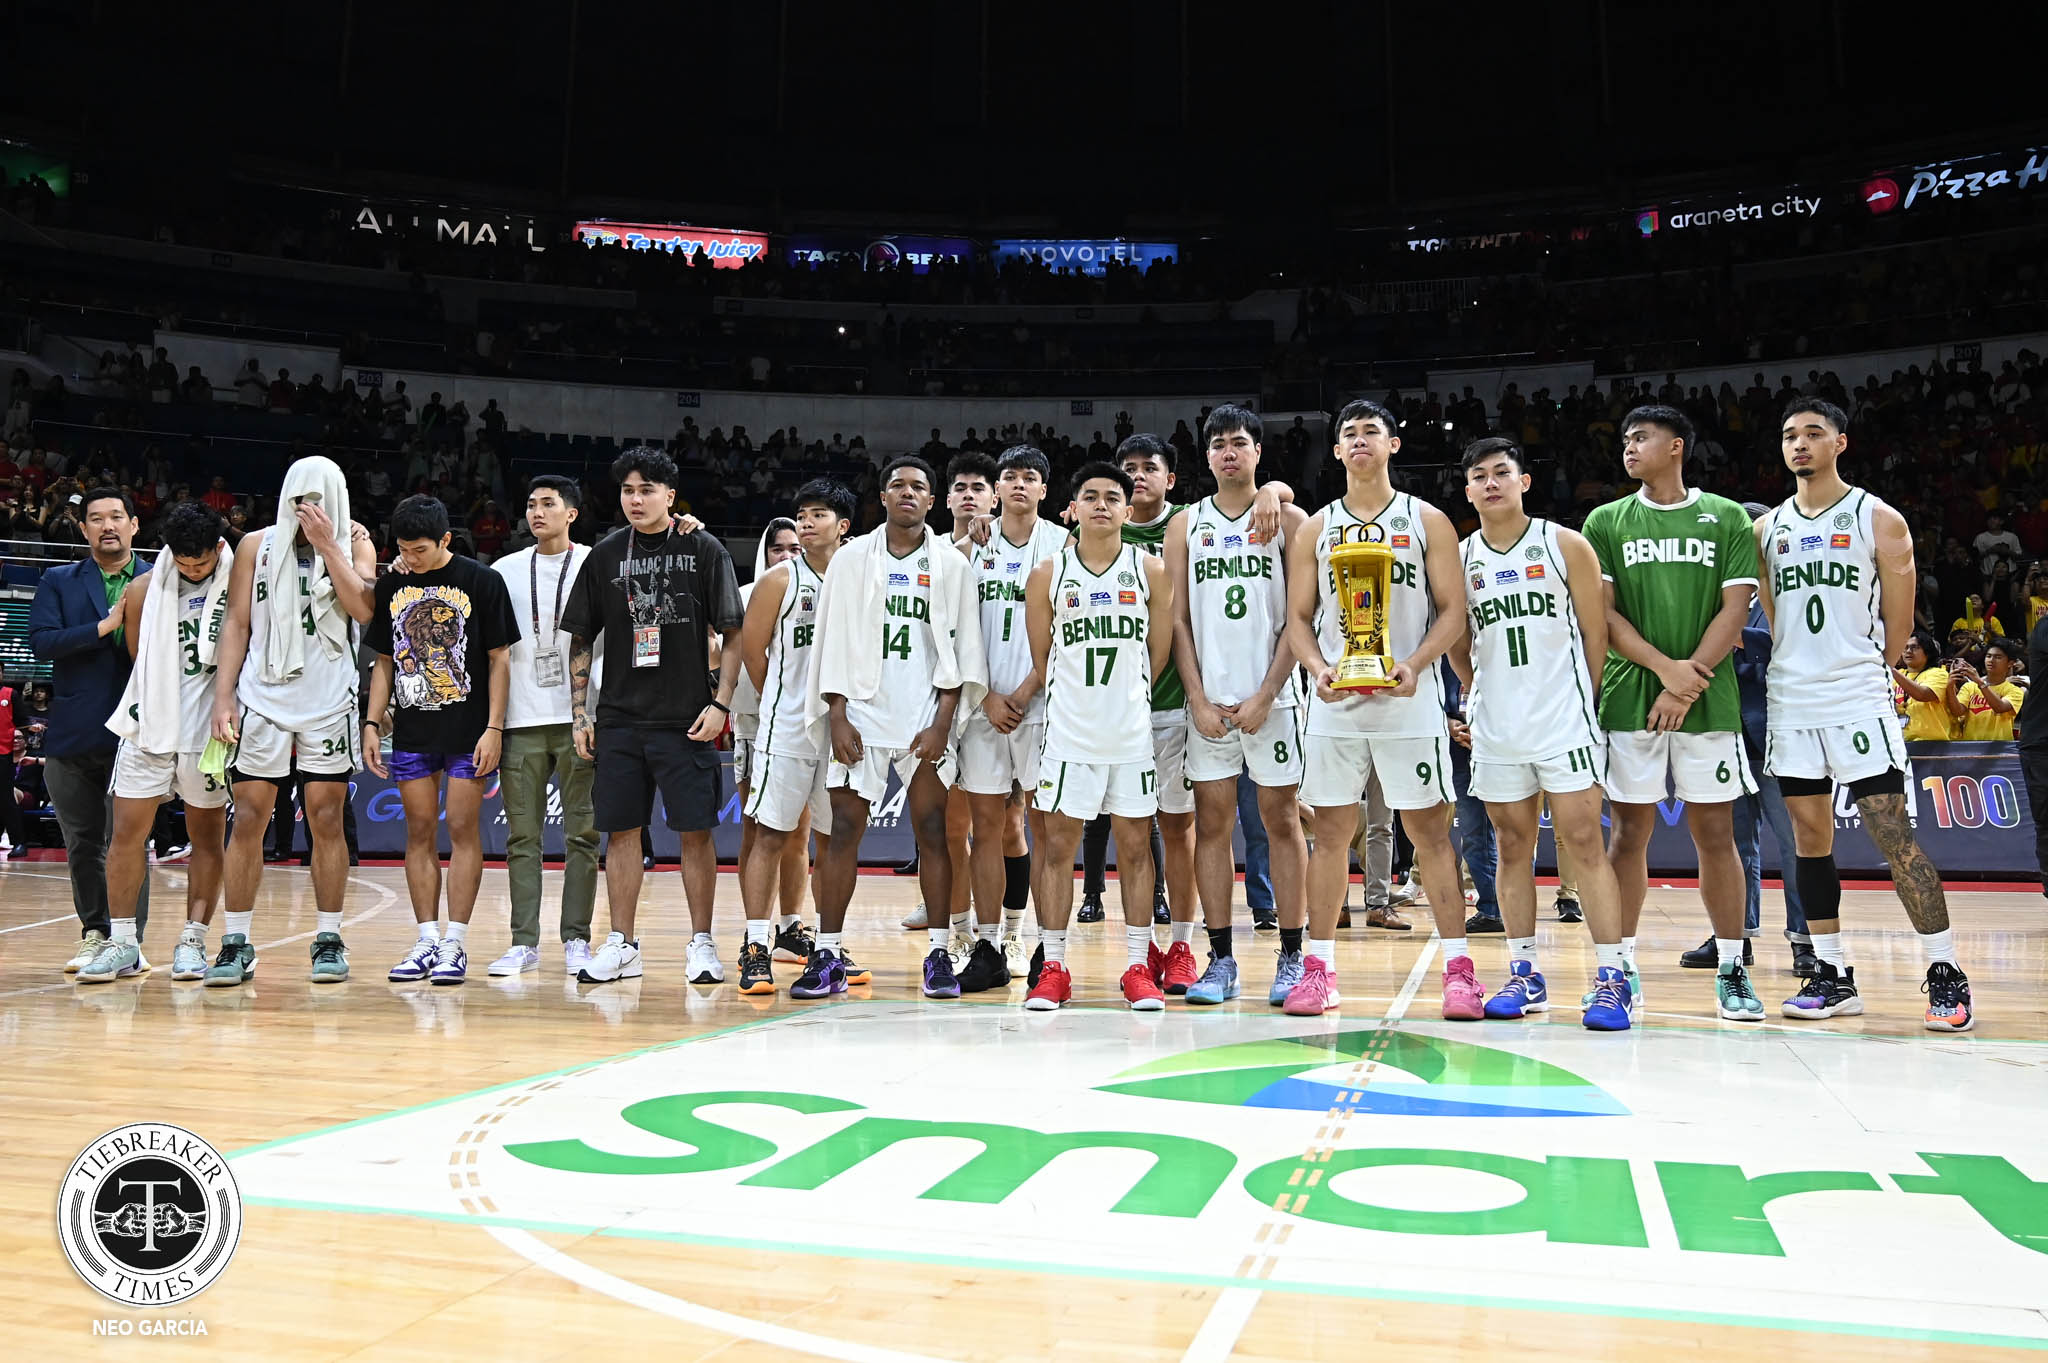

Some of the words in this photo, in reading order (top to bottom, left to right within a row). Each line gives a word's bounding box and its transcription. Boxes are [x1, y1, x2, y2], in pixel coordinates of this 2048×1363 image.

[1904, 168, 2011, 209] Pizza
[1670, 204, 1763, 228] araneta
[1771, 196, 1821, 217] city
[706, 239, 762, 259] Juicy
[1020, 246, 1143, 263] NOVOTEL
[680, 394, 699, 404] 204
[1622, 538, 1716, 568] BENILDE
[889, 573, 909, 581] SGA
[1195, 555, 1273, 584] BENILDE
[1775, 560, 1859, 597] BENILDE
[1067, 598, 1080, 608] 100
[1090, 592, 1111, 600] SGA
[1225, 584, 1247, 620] 8
[1352, 591, 1372, 608] 100
[1002, 607, 1013, 641] 1
[1472, 592, 1557, 631] BENILDE
[1806, 594, 1825, 634] 0
[882, 623, 911, 660] 14
[1062, 615, 1144, 647] BENILDE
[1506, 626, 1529, 668] 11
[1086, 647, 1118, 687] 17
[322, 735, 348, 757] 34
[1274, 740, 1289, 764] 8
[1852, 731, 1870, 755] 0
[1416, 761, 1431, 785] 9
[1568, 746, 1587, 772] 11
[1715, 760, 1730, 784] 6
[1141, 769, 1156, 795] 17
[1921, 774, 2021, 829] 100
[504, 1091, 2048, 1257] Smart
